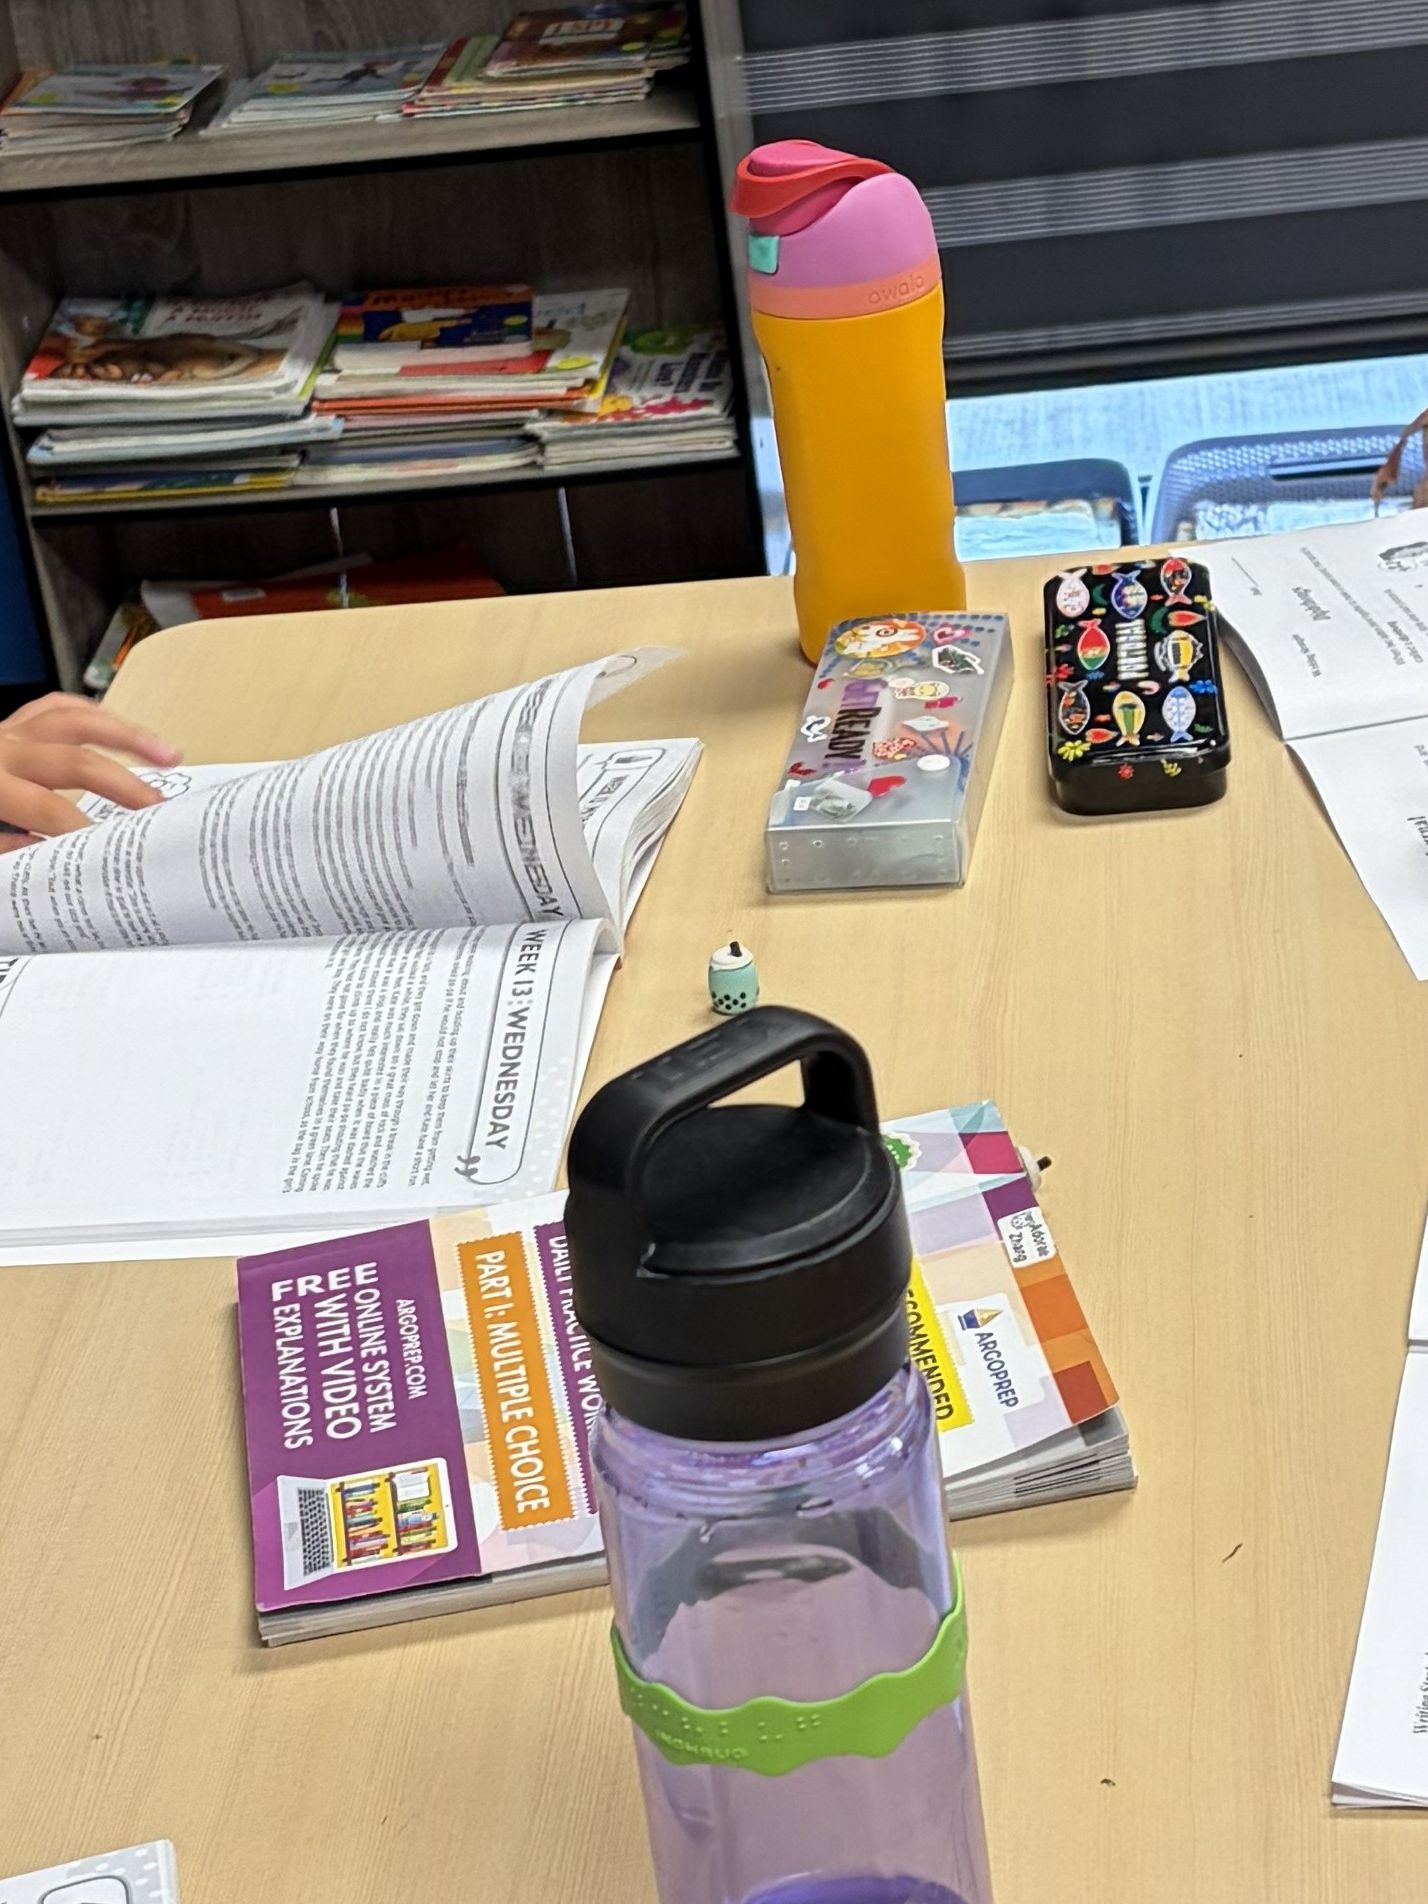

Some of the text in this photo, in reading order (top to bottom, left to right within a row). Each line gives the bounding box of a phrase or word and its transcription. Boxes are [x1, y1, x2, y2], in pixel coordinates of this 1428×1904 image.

[869, 275, 924, 304] owala
[1114, 618, 1148, 679] PORTUGAL
[511, 979, 534, 997] 13
[514, 928, 547, 975] WEEK
[484, 1008, 529, 1149] WEDNESDAY
[272, 1261, 378, 1302] FREE
[474, 1249, 512, 1299] PART
[272, 1302, 313, 1449] EXPLANATIONS
[313, 1292, 362, 1439] WITH VIDEO
[353, 1287, 397, 1433] ONLINE SYSTEM
[395, 1298, 428, 1399] ARGOPREP.COM
[486, 1321, 534, 1423] MULTIPLE
[973, 1331, 1019, 1407] ARGOPREP
[504, 1424, 549, 1513] CHOICE
